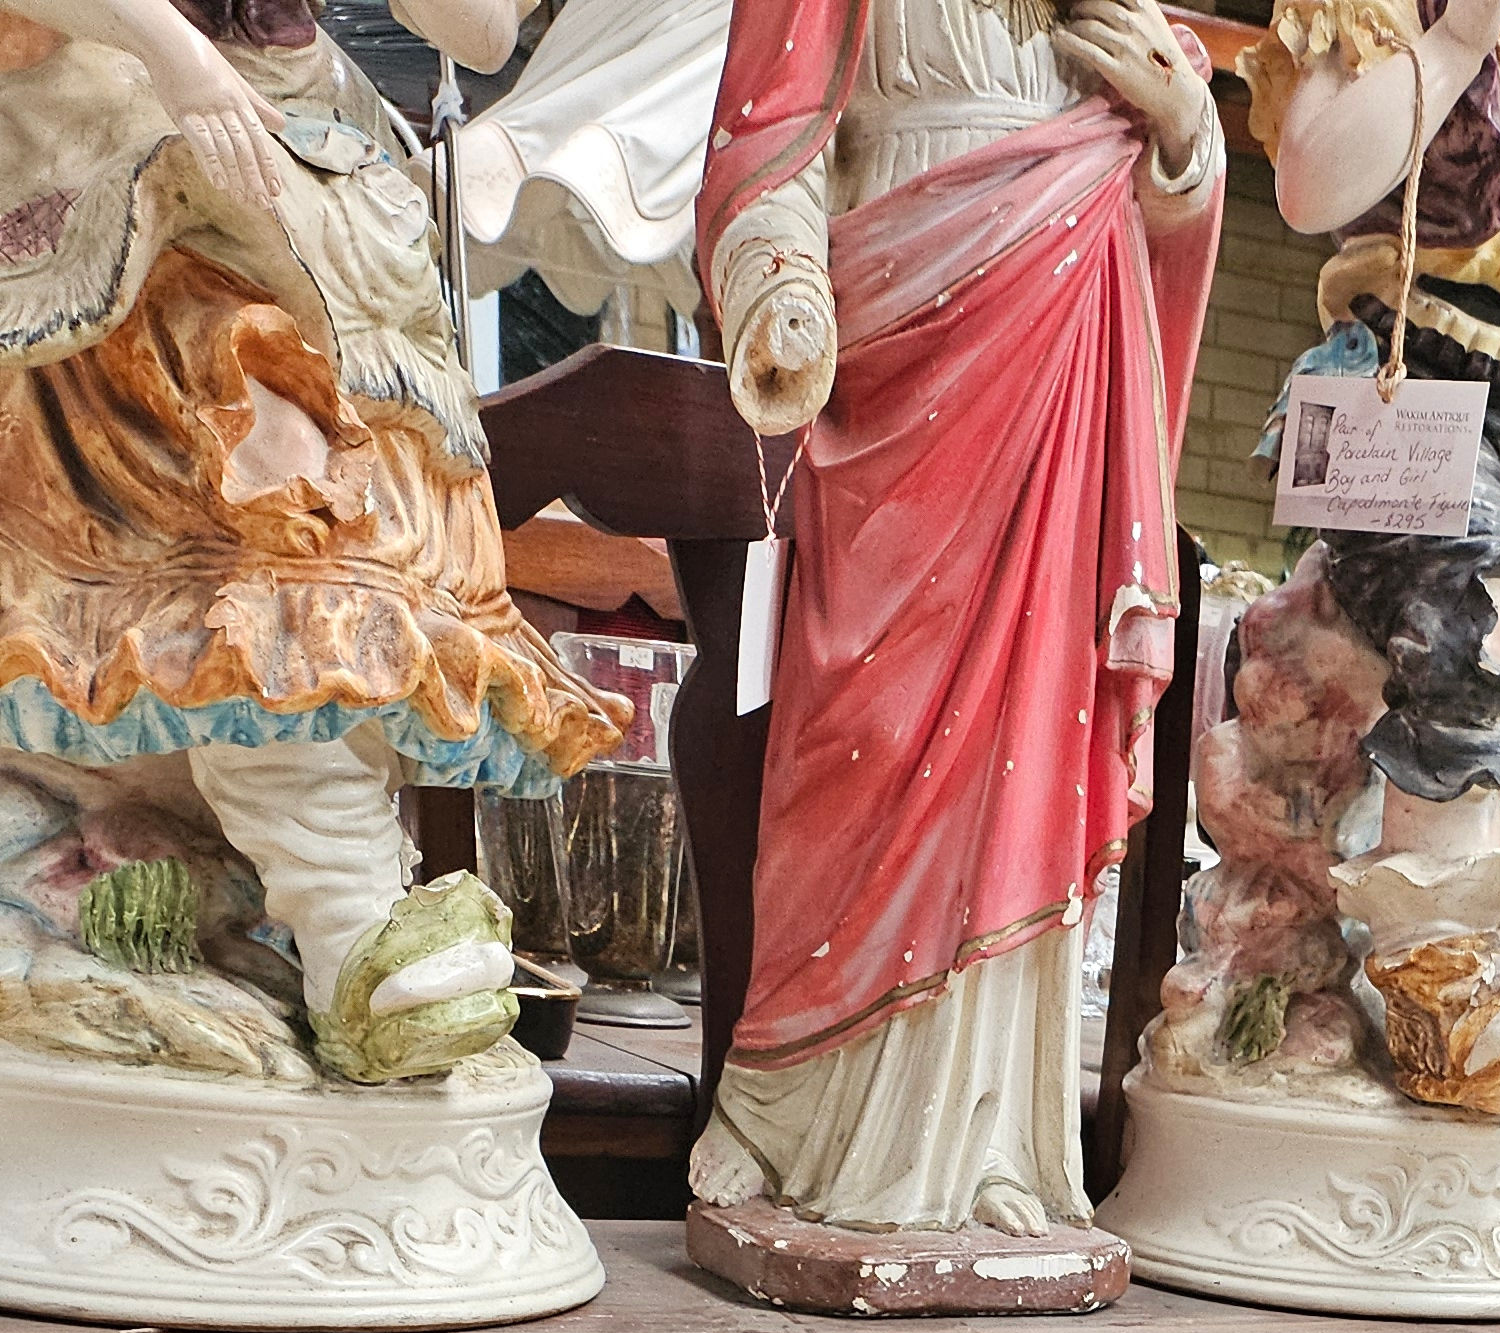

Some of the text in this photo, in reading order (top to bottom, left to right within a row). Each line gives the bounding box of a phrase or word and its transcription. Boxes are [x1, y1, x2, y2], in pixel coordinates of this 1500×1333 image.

[1333, 412, 1384, 442] Pair of
[1408, 441, 1453, 474] Village
[1324, 466, 1428, 495] Boy and Girl
